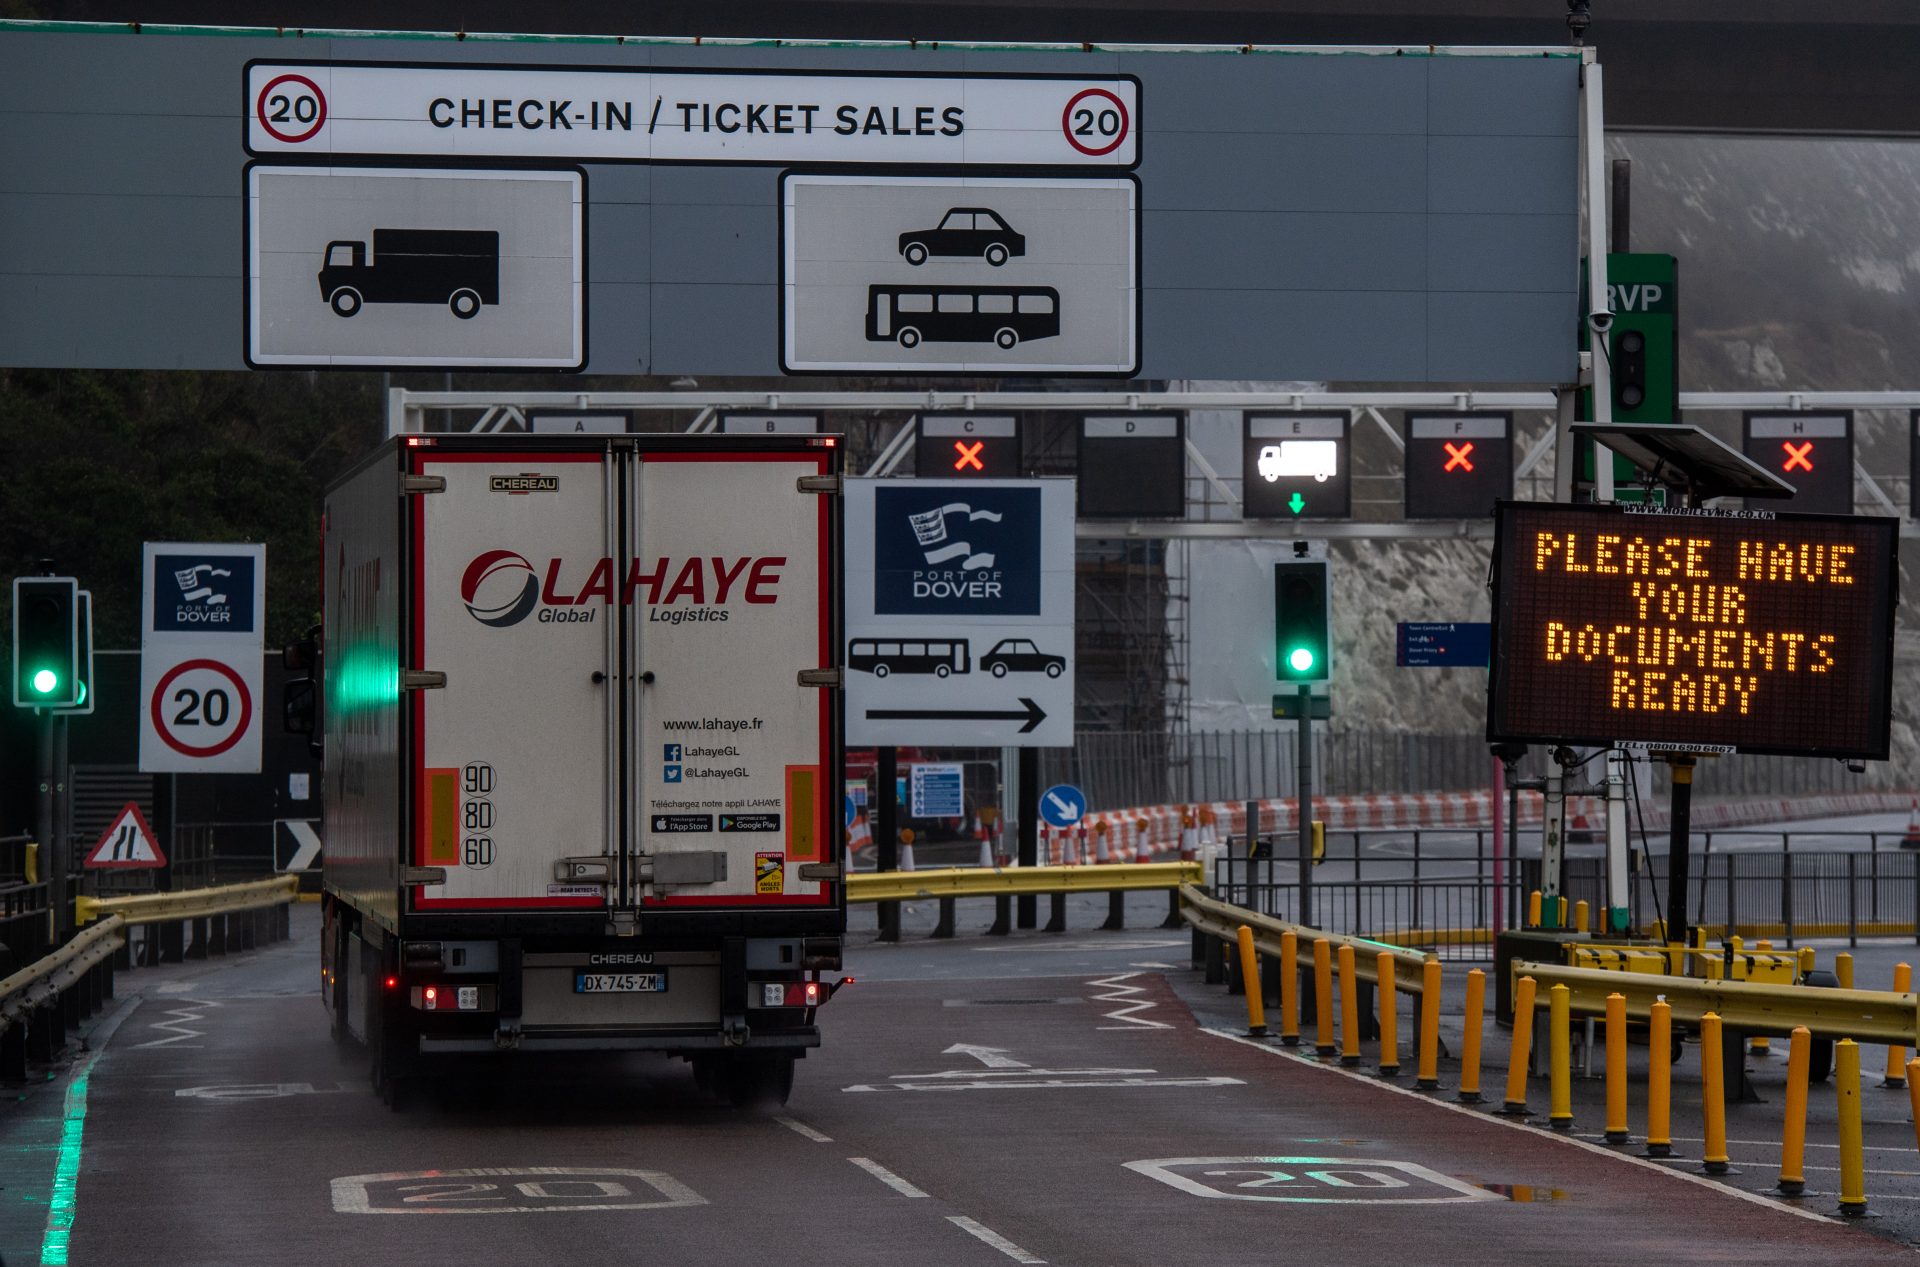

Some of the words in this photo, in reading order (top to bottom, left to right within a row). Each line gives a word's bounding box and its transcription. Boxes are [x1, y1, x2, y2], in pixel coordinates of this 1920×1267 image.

[269, 95, 317, 124] 20
[429, 97, 632, 131] CHECK-IN
[676, 102, 820, 135] TICKET
[833, 105, 965, 137] SALES
[1073, 108, 1120, 137] 20
[575, 421, 585, 433] A
[766, 421, 776, 433] B
[964, 421, 974, 433] C
[1125, 421, 1136, 433] D
[1292, 422, 1301, 434] E
[1455, 422, 1463, 434] F
[1793, 422, 1804, 434] H
[492, 478, 557, 489] CHEREAU
[1535, 532, 1712, 578] PLEASE
[1738, 540, 1856, 584] HAVE
[541, 556, 788, 606] LAHAYE
[913, 571, 967, 581] PORT
[978, 571, 1002, 581] OF
[913, 582, 1002, 598] DOVER
[177, 604, 208, 612] PORT
[215, 604, 230, 612] OF
[1632, 581, 1747, 625] YOUR
[177, 611, 230, 623] DOVER
[537, 607, 596, 623] Global
[649, 607, 730, 625] Logistics
[1546, 622, 1836, 673] DOCUMENTS
[1611, 670, 1758, 715] READY
[173, 688, 231, 727] 20
[663, 717, 763, 733] www.lahaye.fr
[685, 746, 740, 758] LahayeGL
[1616, 741, 1644, 750] TEL:
[1645, 742, 1678, 751] 0800
[1678, 744, 1702, 752] 690
[1703, 745, 1735, 753] 6867
[465, 766, 492, 793] 90
[685, 767, 749, 779] @LahayeGL
[651, 799, 700, 810] Téléchargez
[702, 800, 723, 808] notre
[725, 799, 745, 809] appli
[747, 799, 781, 807] LAHAYE
[465, 802, 492, 829] 80
[736, 821, 761, 831] Google
[762, 821, 777, 831] Play
[465, 838, 492, 865] 60
[590, 954, 653, 964] CHEREAU
[1202, 1170, 1411, 1189] 20
[396, 1181, 632, 1202] 20
